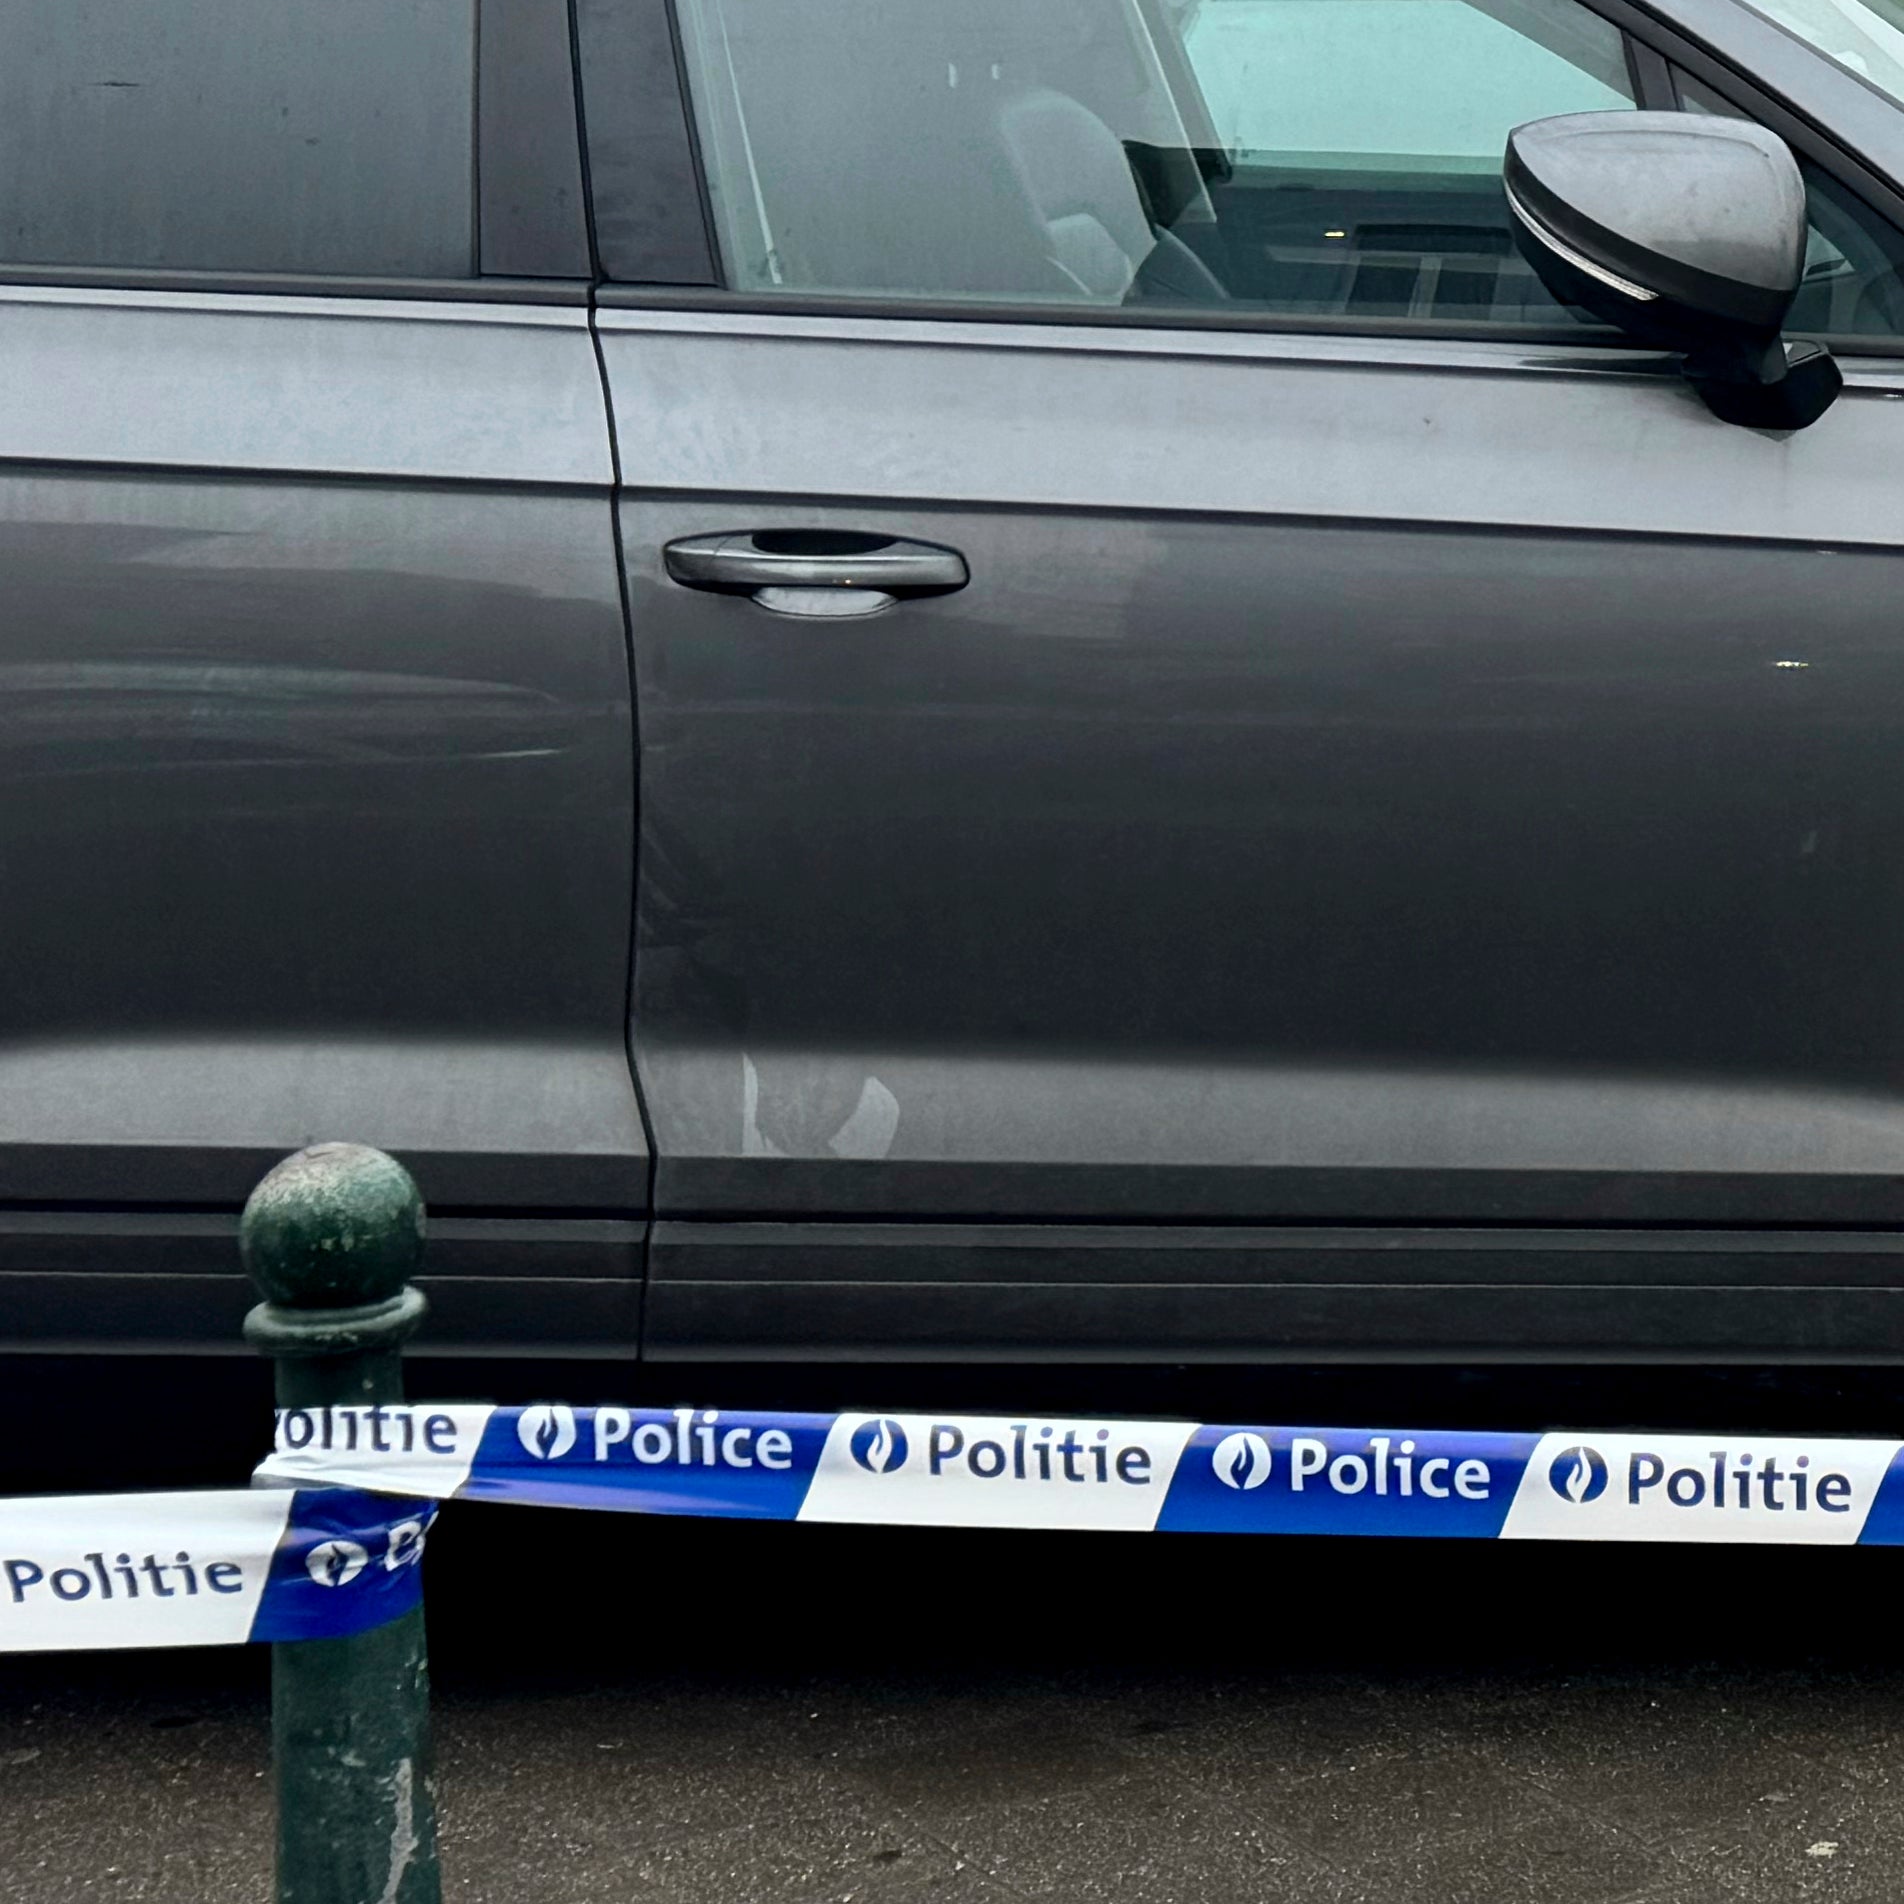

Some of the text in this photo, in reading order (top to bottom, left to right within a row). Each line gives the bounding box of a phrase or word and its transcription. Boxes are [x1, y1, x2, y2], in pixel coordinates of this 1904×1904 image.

[275, 1407, 458, 1454] olitie
[594, 1406, 793, 1470] Police
[927, 1423, 1152, 1486] Politie
[1289, 1436, 1491, 1500] Police
[1627, 1452, 1852, 1514] Politie
[3, 1550, 244, 1604] Politie
